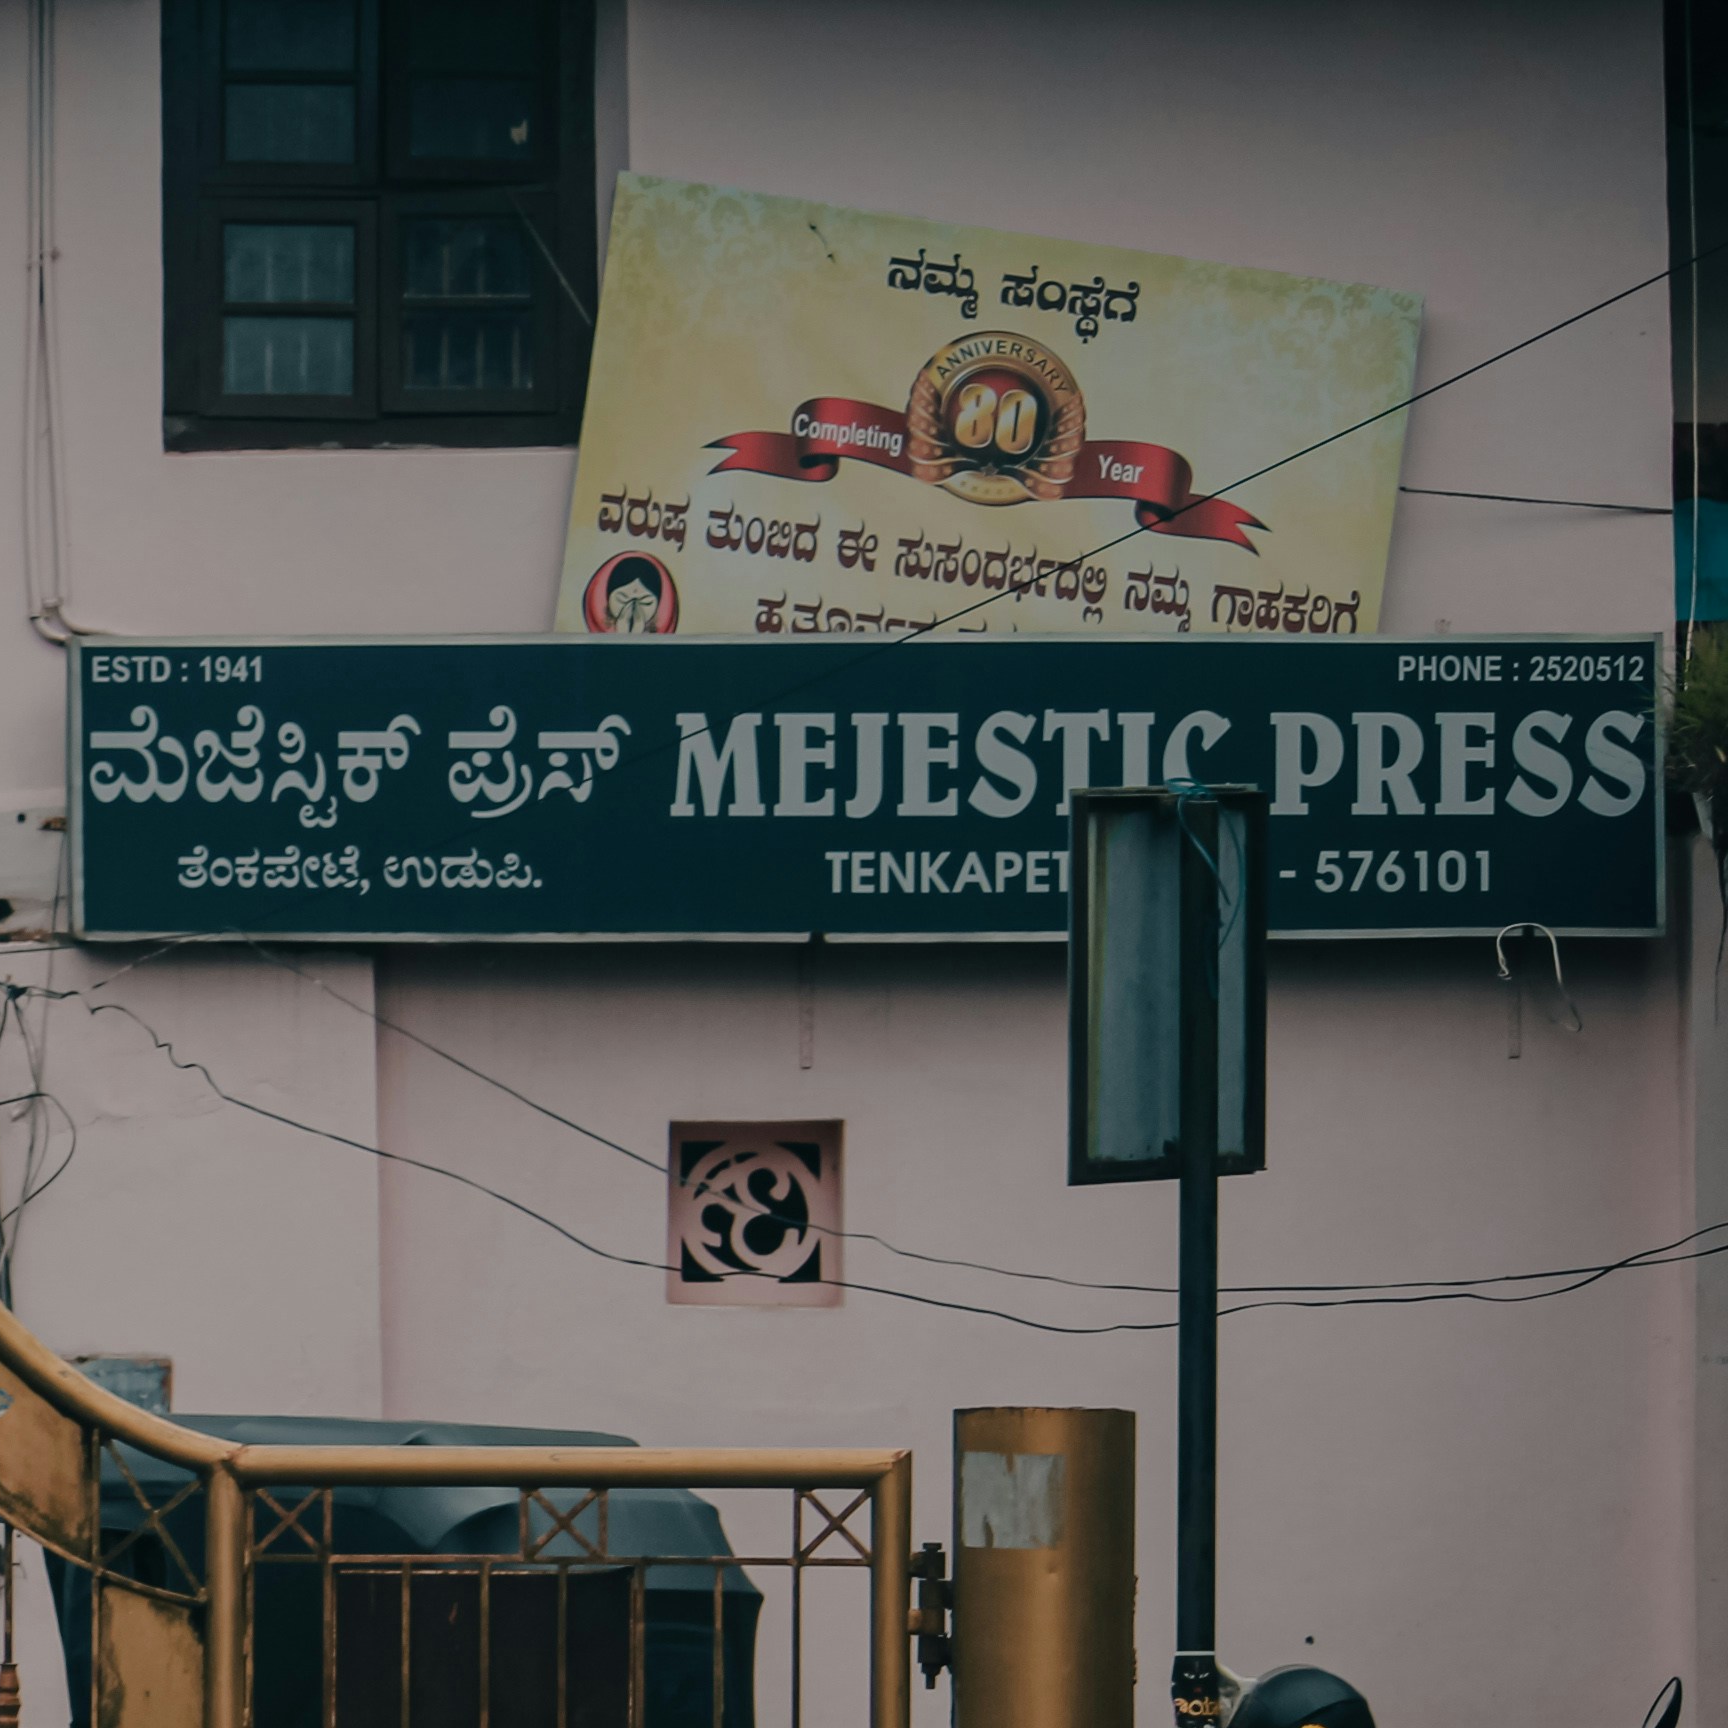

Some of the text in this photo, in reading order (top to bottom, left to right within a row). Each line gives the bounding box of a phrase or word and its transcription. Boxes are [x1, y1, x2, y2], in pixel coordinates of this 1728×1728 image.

[888, 249, 1140, 344] ನಮ್ಮ ಸಂಸ್ಥೆಗೆ
[935, 339, 1069, 395] ANNIVERSARY
[793, 413, 904, 458] Completing
[953, 382, 1039, 456] 80
[1097, 454, 1144, 485] Year
[598, 484, 690, 552] ವರುಷ
[706, 501, 821, 562] ತುಂಬಿದ
[836, 519, 878, 572] ಈ
[1124, 561, 1190, 632] ನಮ್ಮ
[90, 655, 171, 684] ESTD
[199, 655, 263, 684] 1941
[1397, 655, 1502, 683] PHONE
[1529, 655, 1645, 683] 2520512
[89, 704, 633, 829] ಮೆಜೆಸ್ಟಿಕ್ ಪ್ರೆಸ್
[669, 709, 1646, 819] MEJESTIC PRESS
[825, 850, 1071, 894] TENKAPET
[1314, 850, 1491, 893] 576101
